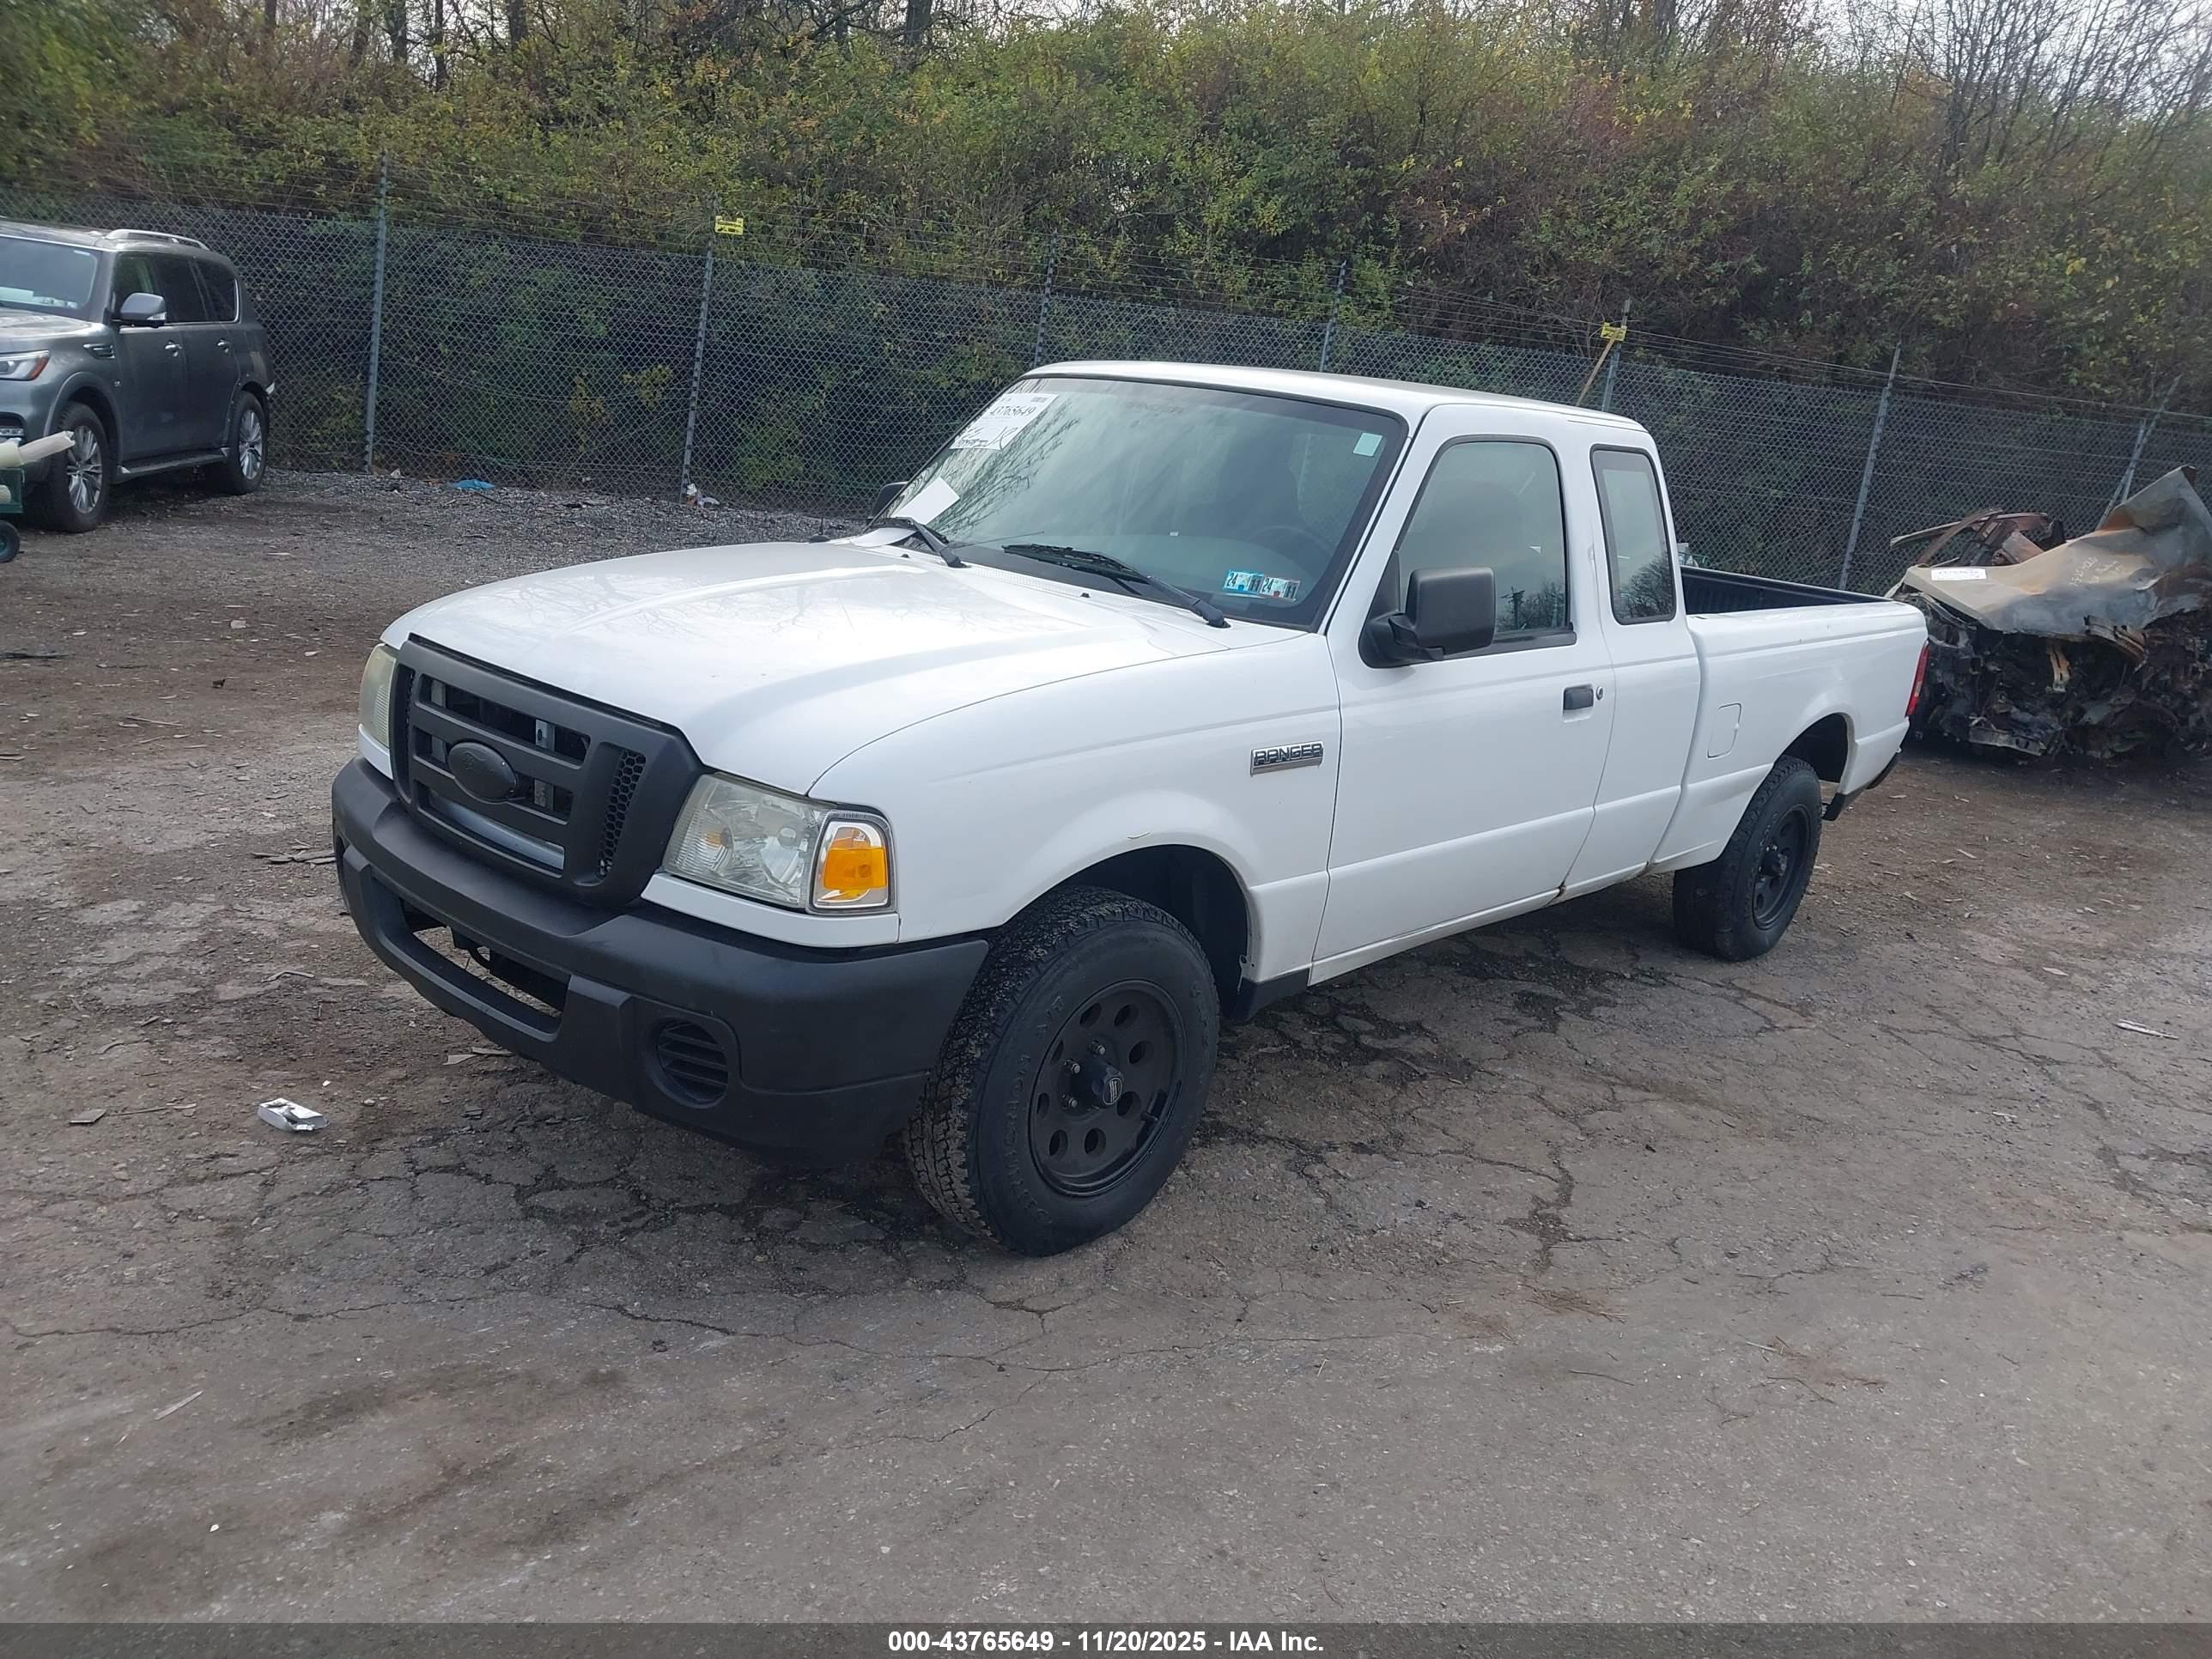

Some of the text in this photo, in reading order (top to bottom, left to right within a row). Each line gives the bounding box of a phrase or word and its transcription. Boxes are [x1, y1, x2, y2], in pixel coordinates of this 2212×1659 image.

[1227, 573, 1237, 586] 24
[1262, 578, 1274, 592] 24
[1254, 744, 1323, 766] RANGER
